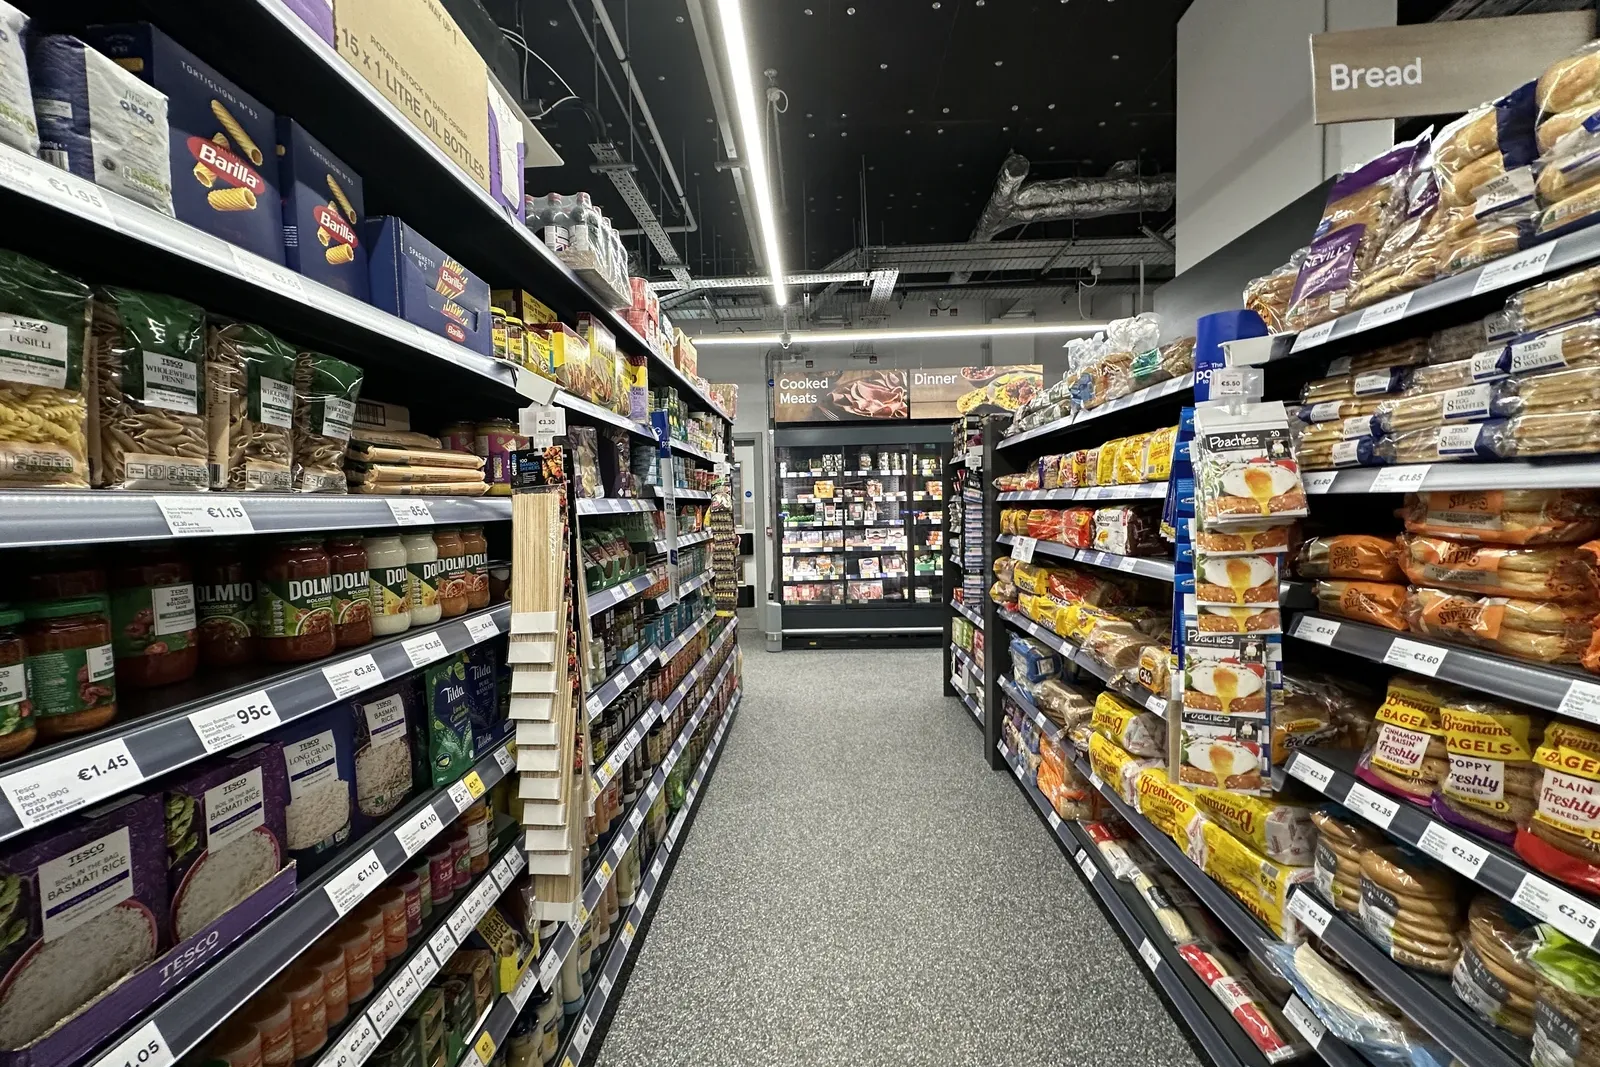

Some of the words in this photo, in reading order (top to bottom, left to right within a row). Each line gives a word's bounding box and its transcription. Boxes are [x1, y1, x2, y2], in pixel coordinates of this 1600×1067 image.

[181, 60, 237, 105] TORTIGLIONI
[1330, 57, 1423, 91] Bread
[370, 35, 400, 71] ROTATE
[400, 67, 424, 98] STOCK
[425, 93, 432, 104] IN
[432, 99, 448, 121] DATE
[449, 118, 468, 141] ORDER
[120, 99, 155, 124] ORZO
[342, 27, 358, 56] 15
[376, 60, 382, 80] 1
[386, 70, 420, 118] LITRE
[423, 108, 442, 139] OIL
[444, 130, 485, 180] BOTTLES
[199, 143, 256, 188] Barilla
[48, 177, 104, 208] €1.95
[319, 210, 355, 243] Barilla
[409, 246, 436, 268] SPAGHETTI
[1302, 242, 1352, 270] NEVILL'S
[1512, 253, 1547, 272] €1.40
[441, 269, 465, 291] Barilla
[13, 319, 48, 331] TESCO
[447, 324, 465, 339] Barilla
[1488, 322, 1496, 334] 8
[10, 334, 51, 350] FUSILLI
[1523, 340, 1547, 352] TESCO
[161, 357, 183, 369] TESCO
[1474, 360, 1482, 372] 8
[1513, 356, 1522, 369] 8
[1523, 352, 1538, 361] EGG
[1523, 353, 1559, 368] WAFFLES
[145, 364, 196, 381] WHOLEWHEAT
[161, 374, 185, 386] PENNE
[914, 373, 958, 386] Dinner
[273, 381, 289, 392] TESCO
[779, 378, 829, 390] Cooked
[779, 392, 818, 405] Meats
[1457, 388, 1476, 398] TESCO
[1446, 401, 1454, 412] 8
[1455, 397, 1470, 405] EGG
[1455, 401, 1485, 411] WAFFLES
[1209, 432, 1259, 448] Poachies
[1440, 436, 1447, 448] 8
[1448, 438, 1473, 447] WAFFLES
[207, 507, 244, 518] €1.15
[410, 505, 429, 518] 85c
[1316, 625, 1335, 636] €3.45
[1413, 651, 1440, 665] €3.60
[354, 663, 377, 677] €3.85
[469, 664, 492, 681] Tilda
[440, 685, 465, 703] Tilda
[376, 699, 392, 710] TESCO
[237, 705, 271, 725] 95c
[374, 706, 398, 721] BASMATI
[381, 714, 395, 724] RICE
[1383, 708, 1441, 731] BAGELS
[202, 726, 215, 735] Pasta
[1441, 713, 1512, 737] Brennans
[476, 733, 493, 749] Tilda
[1286, 734, 1300, 748] Be
[1384, 727, 1424, 742] CINNAMON
[1391, 736, 1416, 748] RAISIN
[299, 738, 320, 751] TESCO
[1379, 740, 1420, 764] Freshly
[1445, 736, 1512, 755] AGELS
[289, 751, 310, 767] LONG
[310, 742, 334, 759] GRAIN
[305, 755, 322, 768] RICE
[1386, 754, 1404, 766] BAKED
[1545, 751, 1600, 774] BAGE
[77, 754, 129, 782] €1.45
[1411, 769, 1420, 778] D
[1449, 758, 1492, 772] POPPY
[223, 777, 247, 793] TESCO
[1310, 770, 1328, 783] €2.35
[1449, 771, 1500, 793] reshly
[13, 782, 40, 797] Tesco
[1140, 774, 1189, 813] Brennans
[1455, 785, 1484, 795] BAKED
[1552, 777, 1594, 796] PLAIN
[17, 791, 36, 803] Red
[20, 797, 47, 811] Pesto
[48, 787, 70, 800] 190G
[210, 800, 243, 822] BASMATI
[244, 789, 261, 804] RICE
[214, 801, 227, 809] BOIL
[1543, 787, 1600, 819] Freshly
[1200, 794, 1256, 835] Brennans
[1370, 801, 1393, 818] €2.35
[1495, 802, 1505, 810] D
[1551, 807, 1580, 822] BAKED
[420, 813, 437, 831] €1.10
[1591, 830, 1600, 841] D
[68, 843, 105, 863] TESCO
[1452, 845, 1481, 867] €2.35
[54, 874, 75, 887] BOIL
[87, 861, 103, 873] THE
[104, 852, 120, 864] BAG
[357, 861, 379, 882] €1.10
[47, 870, 99, 901] BASMATI
[102, 856, 126, 874] RICE
[468, 899, 481, 914] €2.40
[453, 915, 467, 931] €2.40
[1308, 908, 1327, 927] €2.45
[1558, 904, 1597, 930] €2.35
[482, 913, 504, 941] BREAD
[436, 935, 450, 952] €2.40
[491, 925, 508, 948] SAUCE
[159, 930, 219, 978] TESCO
[416, 957, 432, 975] €2.40
[397, 977, 414, 997] €2.40
[376, 1000, 394, 1023] €2.40
[582, 1018, 593, 1036] €1
[1302, 1016, 1322, 1038] €2.20
[350, 1028, 371, 1052] €2.40
